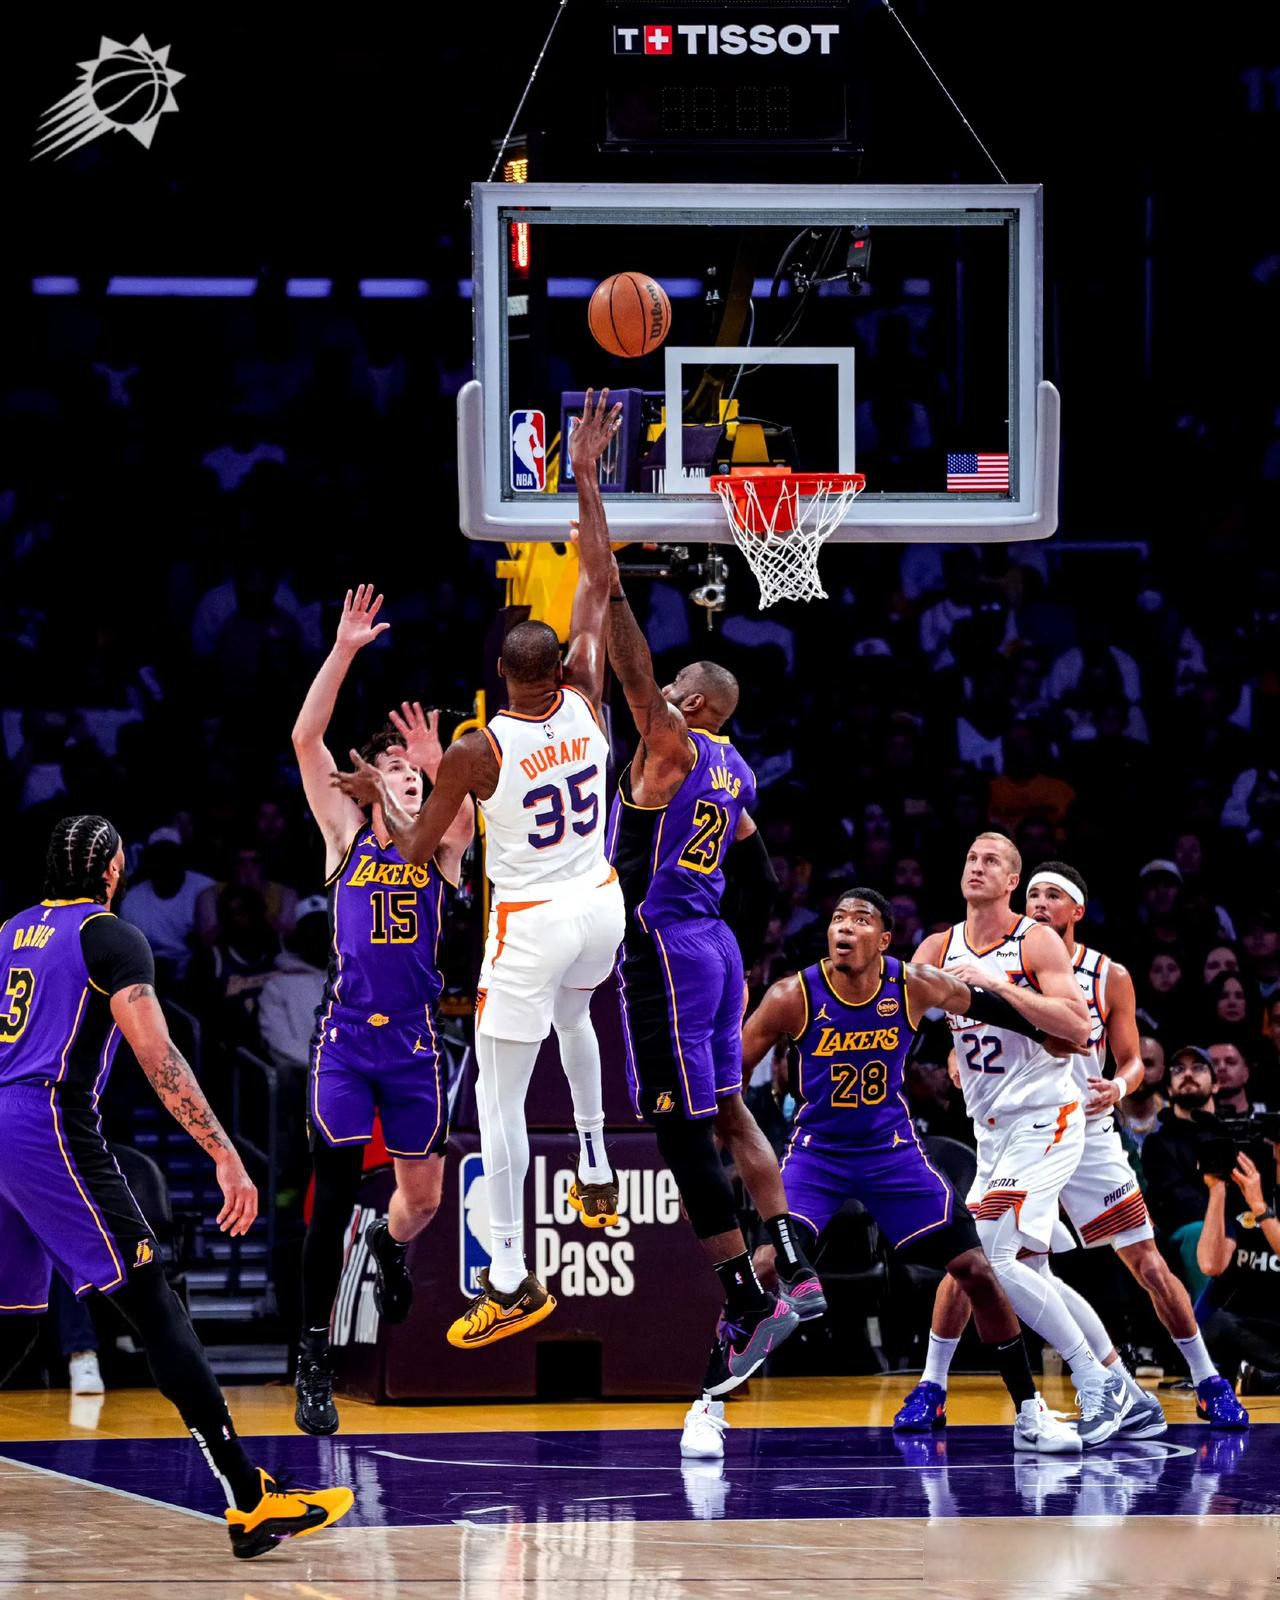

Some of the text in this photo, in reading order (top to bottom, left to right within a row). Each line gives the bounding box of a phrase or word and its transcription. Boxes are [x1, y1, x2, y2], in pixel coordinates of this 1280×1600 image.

[678, 24, 840, 55] TISSOT
[646, 284, 663, 340] Wilson
[516, 473, 533, 487] NBA
[520, 737, 590, 780] DURANT
[522, 764, 599, 850] 35
[677, 799, 729, 875] 23
[346, 855, 430, 888] LAKERS
[13, 924, 56, 950] DAVIS
[370, 891, 418, 944] 15
[0, 967, 35, 1044] 3
[811, 1027, 899, 1056] LAKERS
[961, 1033, 1005, 1074] 22
[831, 1060, 887, 1108] 28
[535, 1156, 680, 1238] Legue
[535, 1228, 635, 1297] Pass
